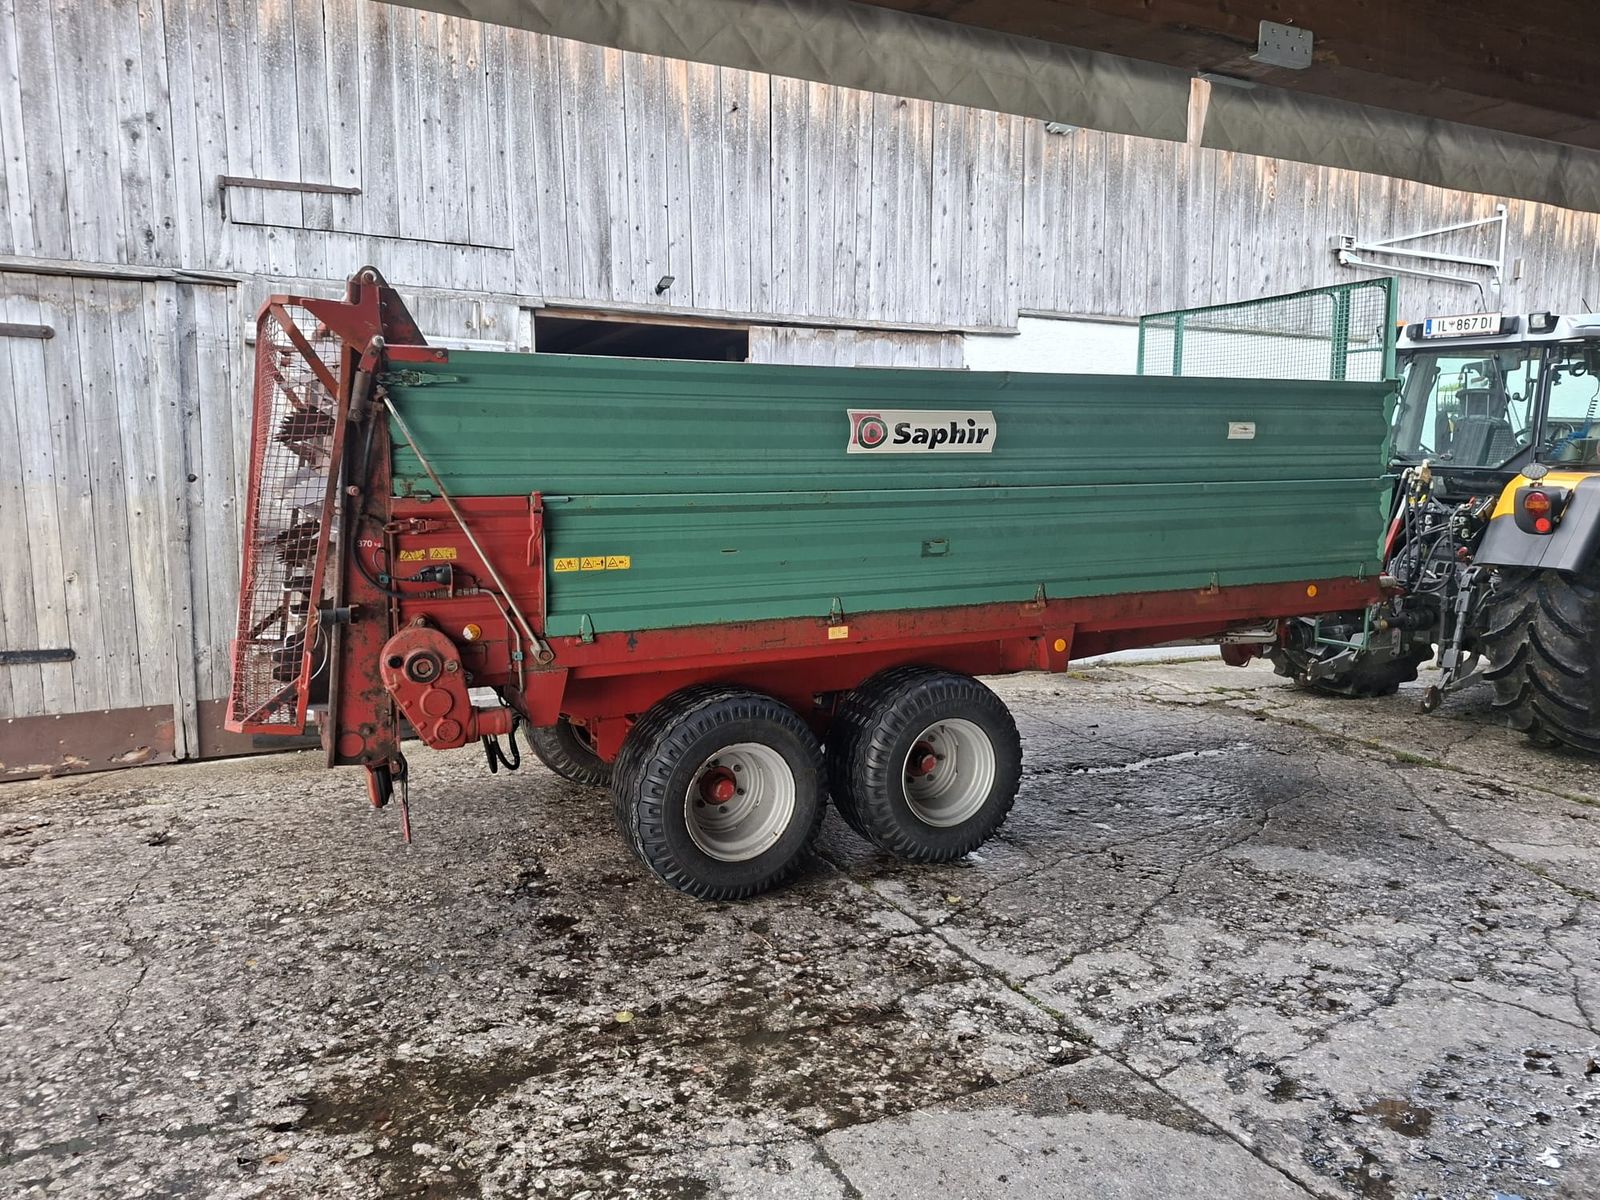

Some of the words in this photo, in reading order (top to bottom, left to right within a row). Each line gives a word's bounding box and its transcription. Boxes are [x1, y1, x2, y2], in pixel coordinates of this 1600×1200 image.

[1437, 320, 1447, 332] IL
[1456, 318, 1478, 331] 867
[1480, 317, 1493, 329] DI
[892, 418, 989, 449] Saphir
